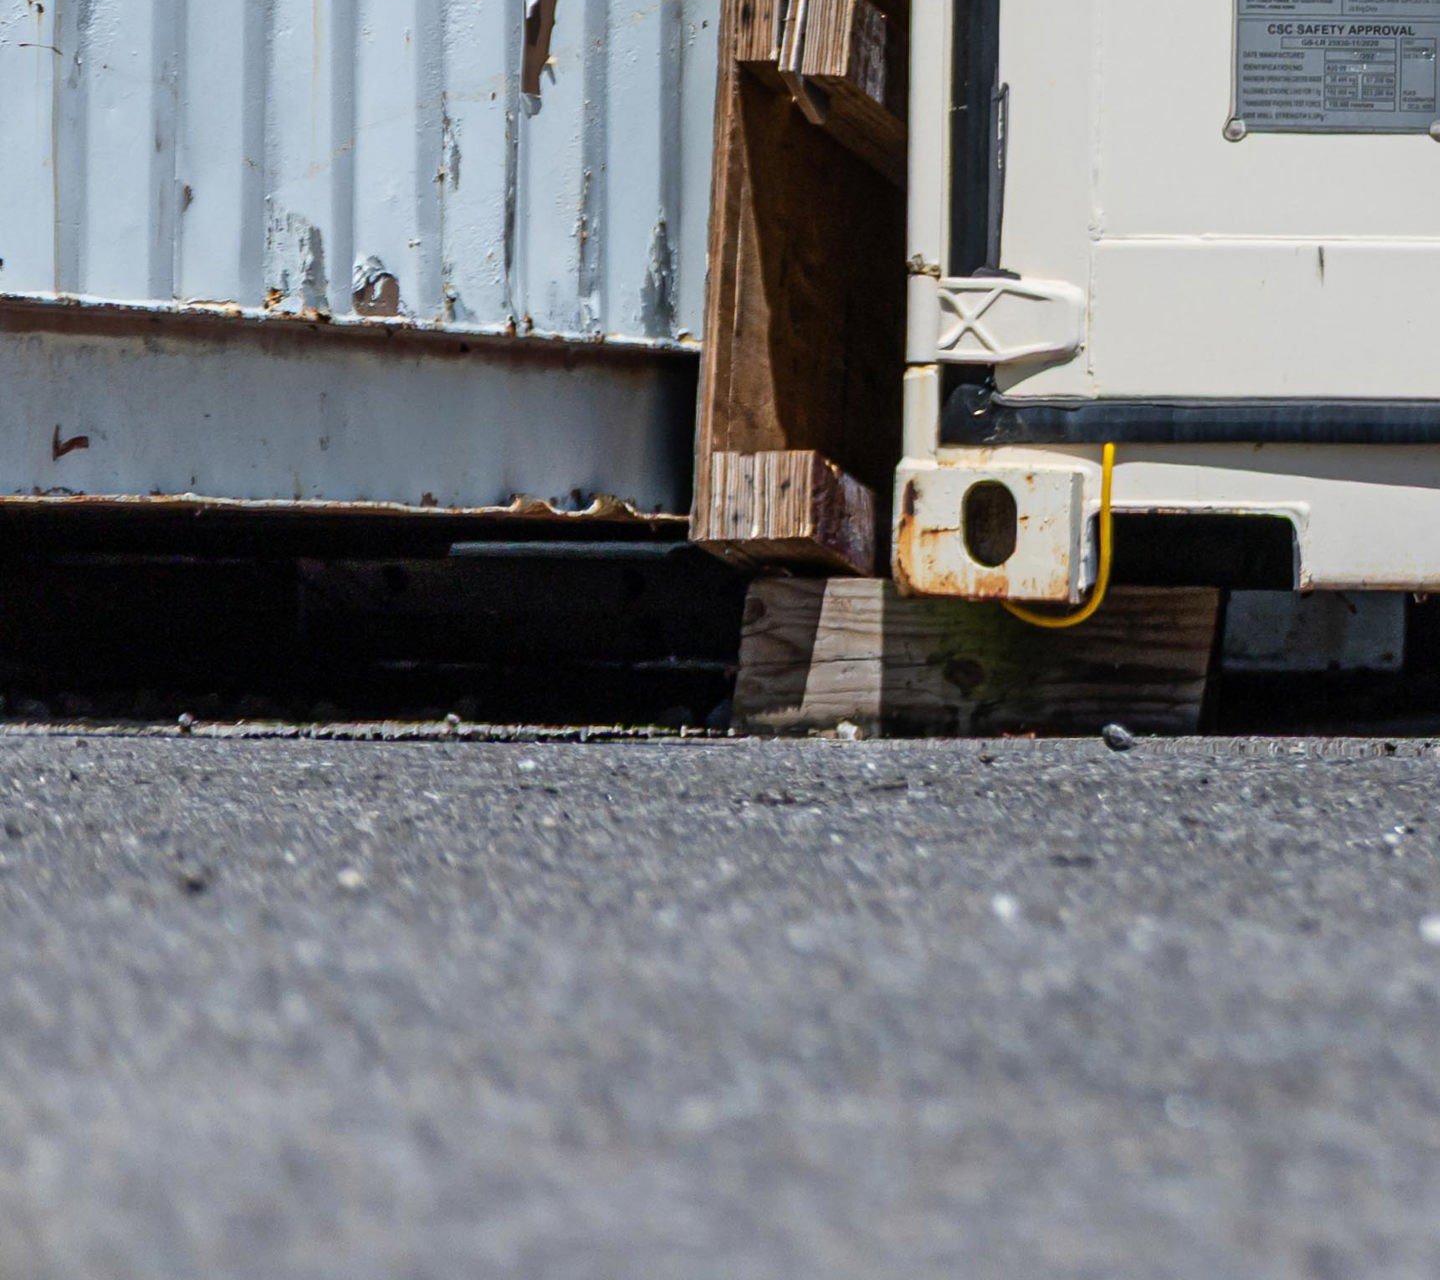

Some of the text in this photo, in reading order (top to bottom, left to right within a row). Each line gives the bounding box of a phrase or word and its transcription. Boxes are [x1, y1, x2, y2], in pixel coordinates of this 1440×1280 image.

[1267, 24, 1416, 36] CSC SAFETY APPROVAL
